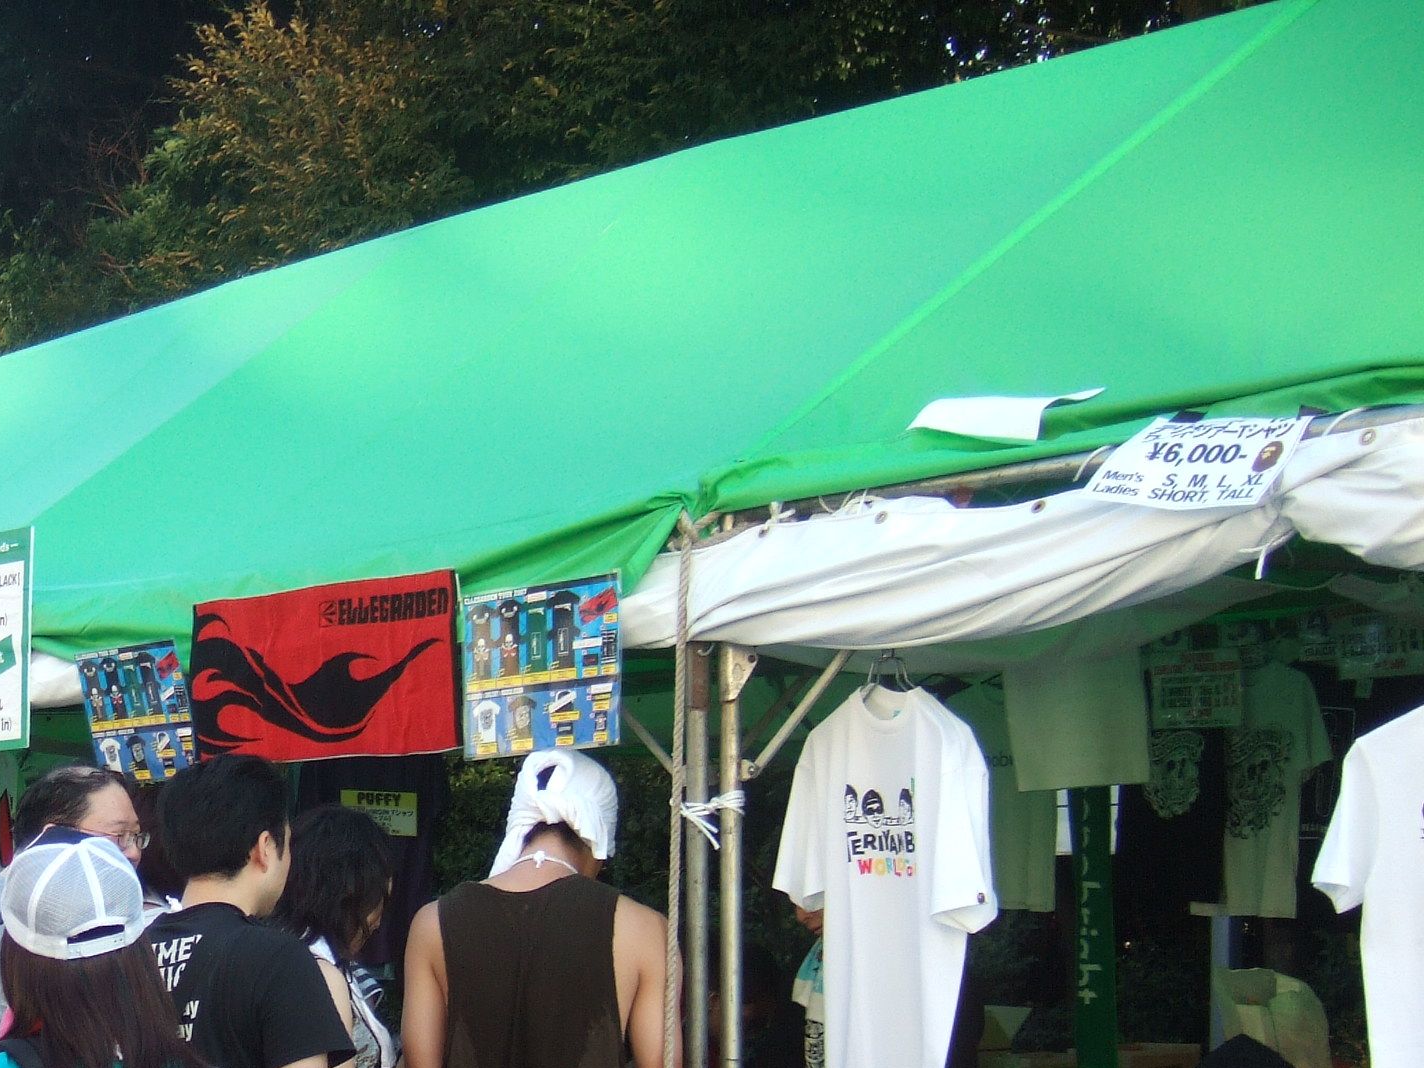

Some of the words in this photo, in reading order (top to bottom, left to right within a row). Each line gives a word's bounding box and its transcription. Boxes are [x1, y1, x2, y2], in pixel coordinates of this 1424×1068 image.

[1147, 442, 1247, 467] ¥6,000-
[1102, 470, 1144, 483] Men's
[1241, 474, 1263, 486] XL
[1093, 484, 1140, 497] Ladies
[1217, 488, 1255, 500] TALL
[338, 587, 449, 625] ELLEGARDEN
[357, 792, 401, 807] PUFFY
